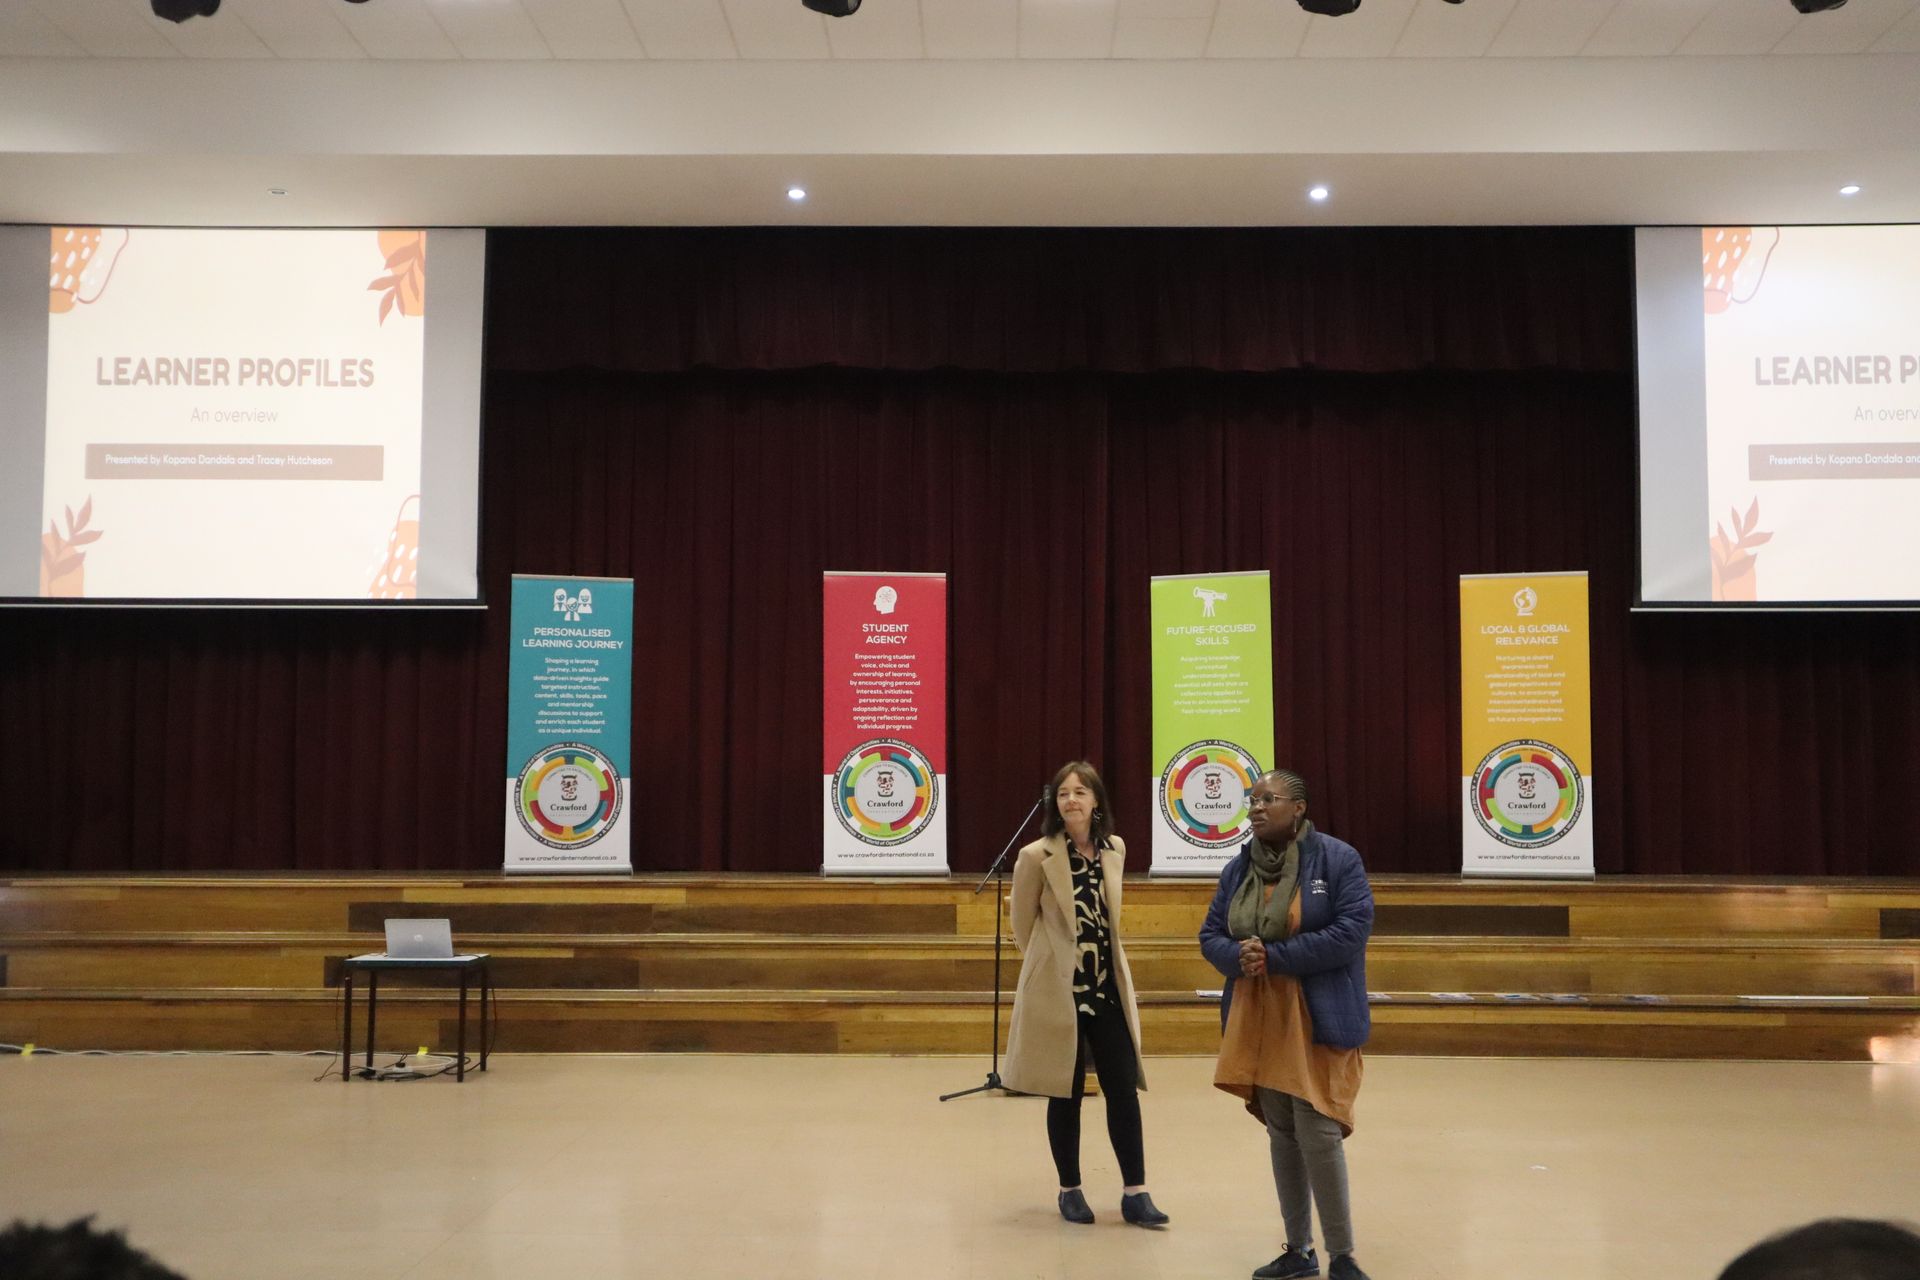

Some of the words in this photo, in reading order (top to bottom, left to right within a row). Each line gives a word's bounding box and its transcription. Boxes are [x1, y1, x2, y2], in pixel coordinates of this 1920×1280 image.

[96, 356, 230, 386] LEARNER
[238, 358, 374, 388] PROFILES
[1755, 356, 1892, 386] LEARNER
[1900, 354, 1920, 384] P
[190, 407, 209, 423] An
[214, 407, 279, 423] overview
[1854, 406, 1874, 422] An
[1878, 405, 1920, 422] overv
[105, 454, 148, 465] Presented
[150, 454, 161, 466] by
[237, 455, 254, 465] and
[256, 455, 286, 467] Tracey
[287, 455, 333, 466] Hutcheson
[1769, 454, 1814, 465] Presented
[1816, 454, 1826, 466] by
[534, 627, 612, 637] PERSONALISED
[862, 624, 909, 632] STUDENT
[1166, 624, 1256, 636] FUTURE-FOCUSED
[1481, 625, 1516, 634] LOCAL
[1527, 624, 1570, 634] GLOBAL
[522, 638, 573, 648] LEARNING
[574, 640, 624, 649] JOURNEY
[866, 636, 908, 644] AGENCY
[1195, 636, 1230, 646] SKILLS
[1495, 636, 1559, 646] RELEVANCE
[1508, 802, 1546, 810] Crawford
